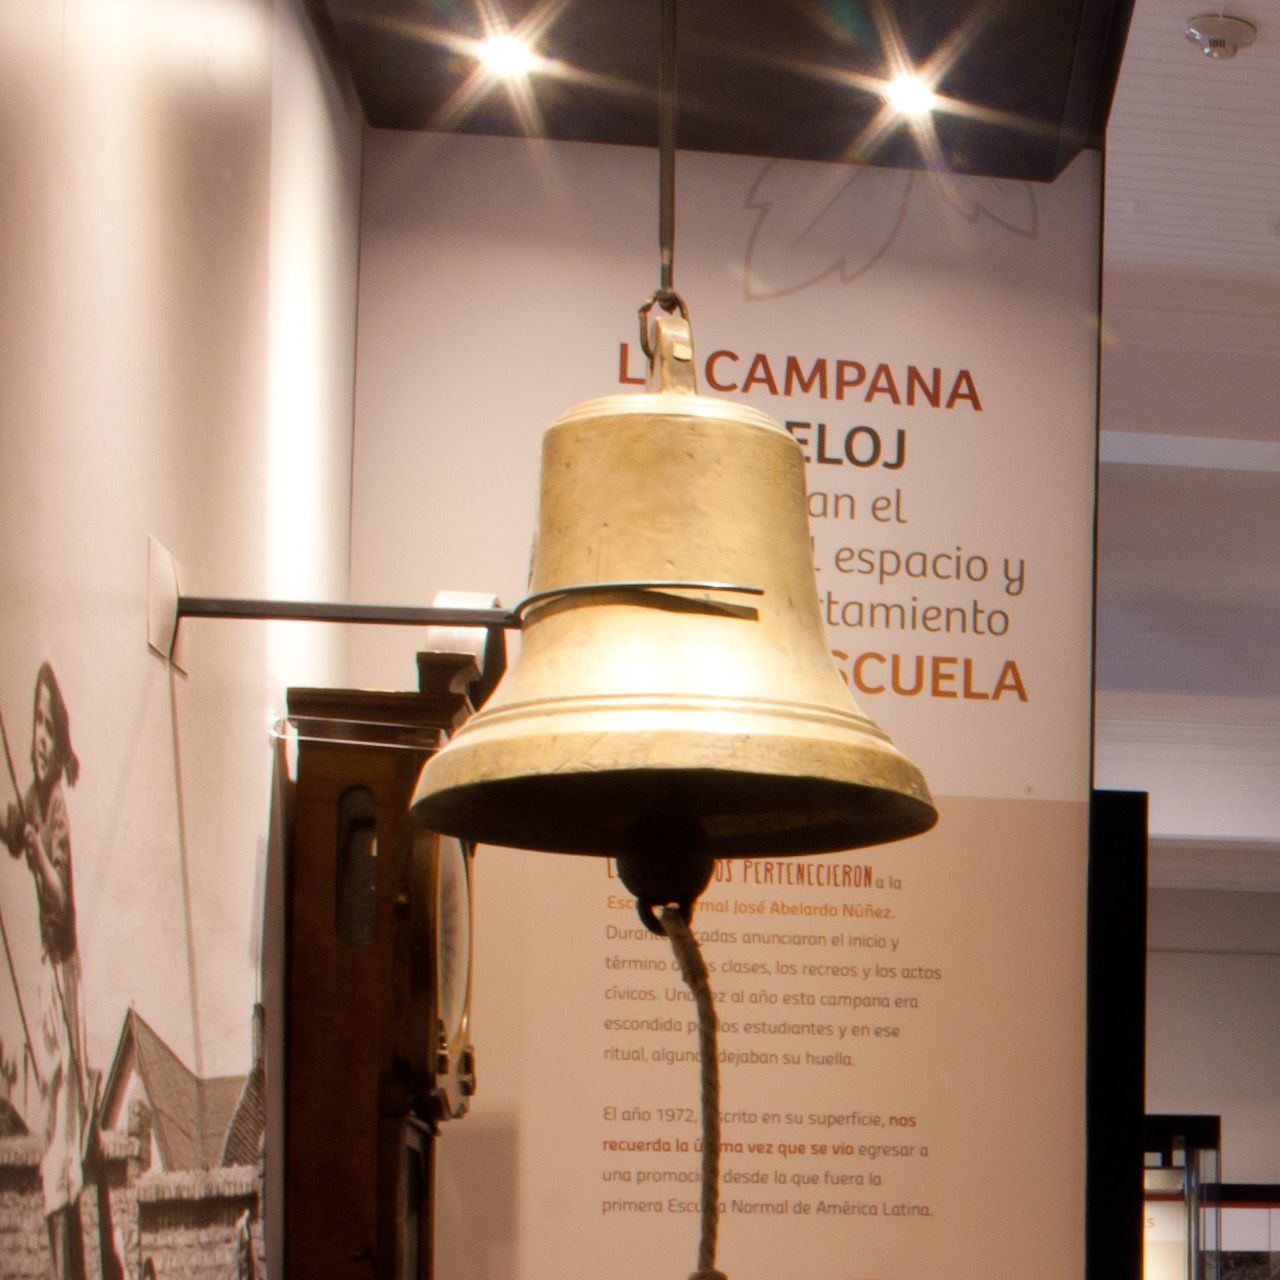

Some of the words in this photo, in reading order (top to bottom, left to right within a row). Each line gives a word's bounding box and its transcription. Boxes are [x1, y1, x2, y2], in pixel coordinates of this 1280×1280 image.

[704, 350, 983, 411] CAMPANA
[784, 421, 907, 470] ELOJ
[871, 488, 908, 523] el
[835, 545, 988, 584] espacio
[1003, 557, 1025, 595] y
[743, 860, 873, 889] PERTENECIERON
[876, 878, 885, 889] a
[889, 875, 902, 890] la
[733, 901, 765, 916] José
[770, 903, 838, 918] Abelardo
[842, 903, 896, 919] Núñez.
[742, 933, 827, 947] anunciaron
[831, 933, 844, 947] el
[848, 934, 886, 949] inicio
[890, 938, 900, 953] y
[605, 956, 667, 972] término
[721, 959, 772, 976] clases,
[776, 961, 798, 975] los
[803, 964, 857, 978] recreos
[862, 966, 871, 981] y
[875, 963, 897, 978] los
[901, 966, 942, 980] actos
[605, 986, 657, 1001] cívicos.
[731, 991, 745, 1004] al
[749, 989, 778, 1005] año
[783, 993, 815, 1006] esta
[820, 995, 890, 1010] campana
[894, 996, 919, 1009] era
[604, 1018, 683, 1032] escondida
[744, 1021, 834, 1036] estudiantes
[838, 1025, 847, 1039] y
[852, 1025, 870, 1037] en
[875, 1025, 900, 1038] ese
[604, 1048, 648, 1063] ritual,
[719, 1050, 778, 1067] dejaban
[783, 1052, 801, 1065] su
[805, 1050, 855, 1066] huella.
[603, 1106, 618, 1121] El
[622, 1107, 651, 1123] año
[657, 1108, 698, 1125] 1972,
[762, 1112, 781, 1125] en
[785, 1113, 803, 1125] su
[808, 1112, 885, 1128] superficie,
[889, 1115, 916, 1127] nos
[603, 1138, 671, 1152] recuerda
[676, 1138, 689, 1152] la
[748, 1142, 773, 1154] vez
[778, 1143, 806, 1158] que
[810, 1143, 828, 1155] se
[832, 1142, 854, 1156] vio
[858, 1145, 914, 1159] egresar
[920, 1145, 929, 1157] a
[603, 1170, 632, 1182] una
[723, 1169, 769, 1184] desde
[774, 1170, 788, 1184] la
[792, 1172, 820, 1189] que
[824, 1170, 863, 1186] fuera
[869, 1172, 882, 1186] la
[602, 1199, 663, 1216] primera
[732, 1200, 788, 1215] Normal
[793, 1201, 811, 1215] de
[816, 1202, 877, 1217] América
[882, 1203, 934, 1217] Latina.
